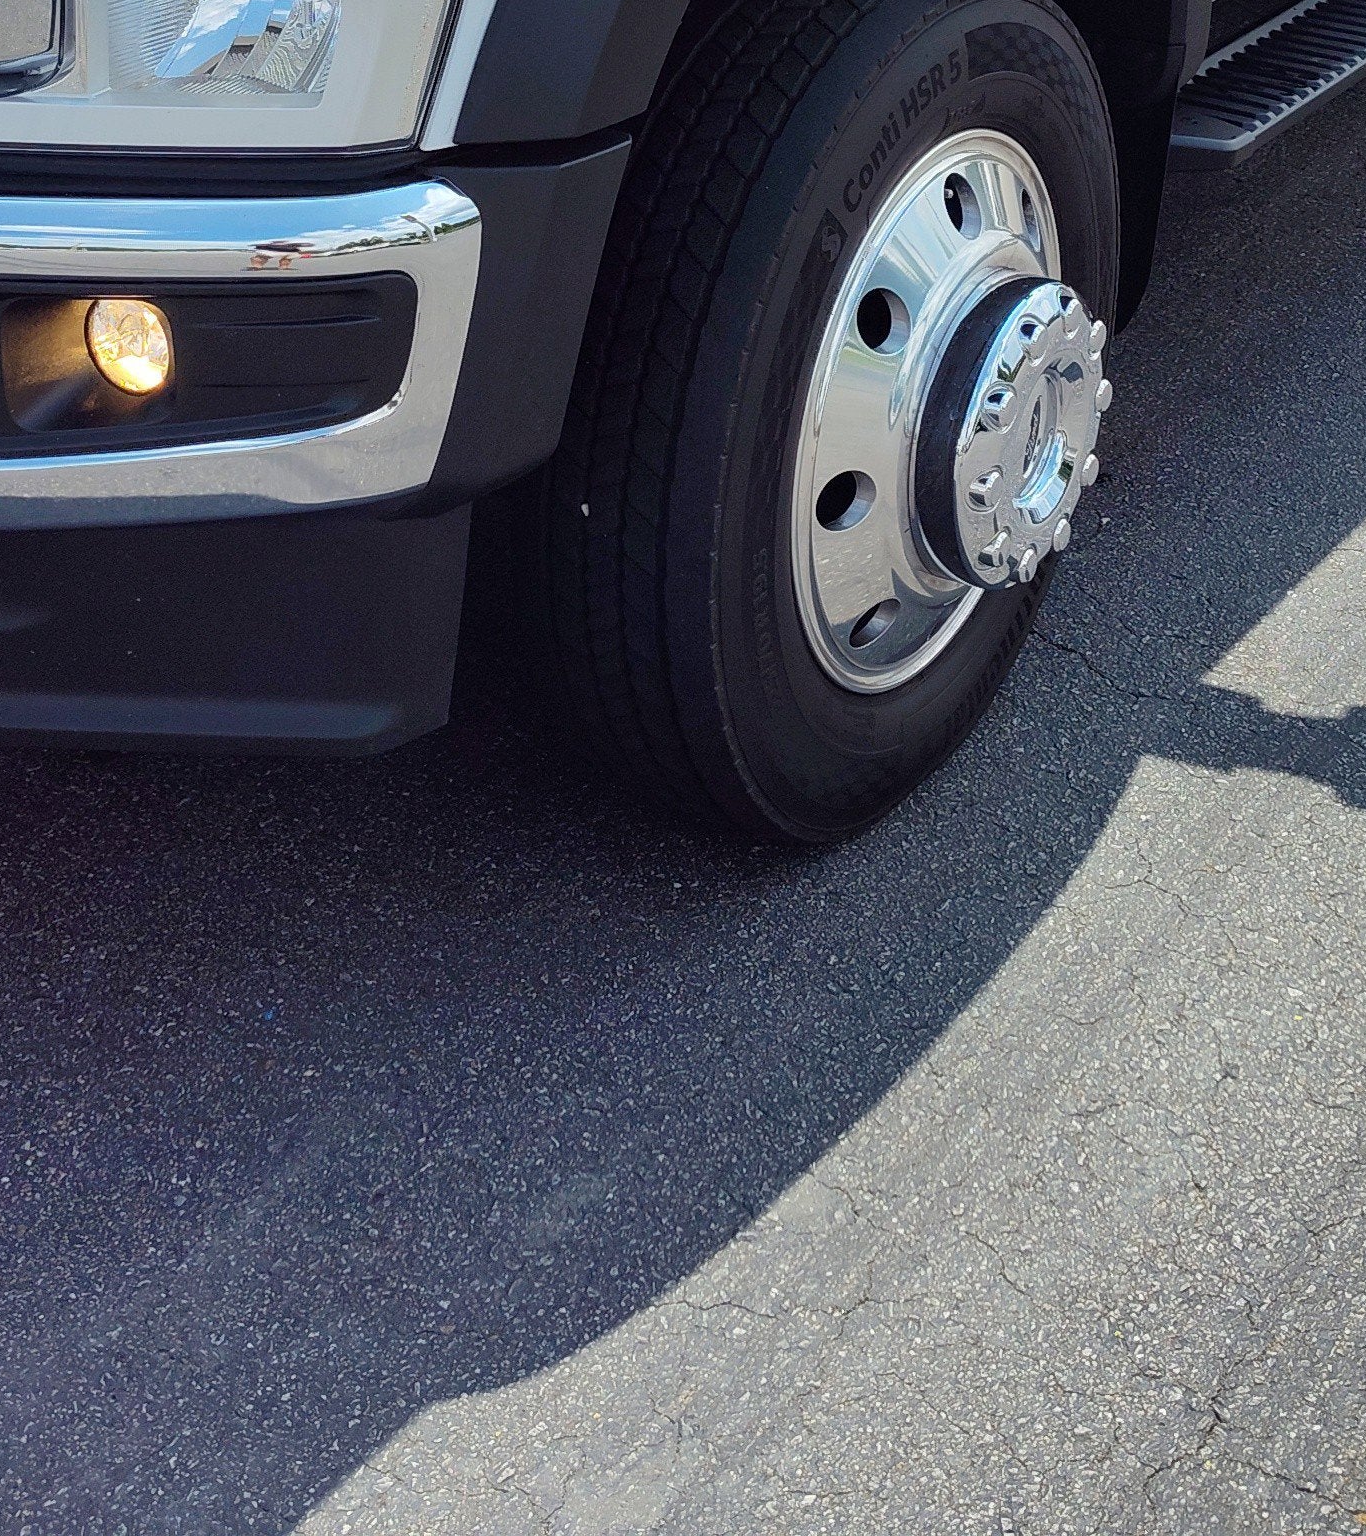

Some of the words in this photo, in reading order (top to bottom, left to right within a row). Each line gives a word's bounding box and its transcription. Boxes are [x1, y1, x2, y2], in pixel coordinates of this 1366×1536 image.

[841, 111, 902, 214] Conti
[899, 63, 947, 130] HSR
[947, 49, 963, 85] 5
